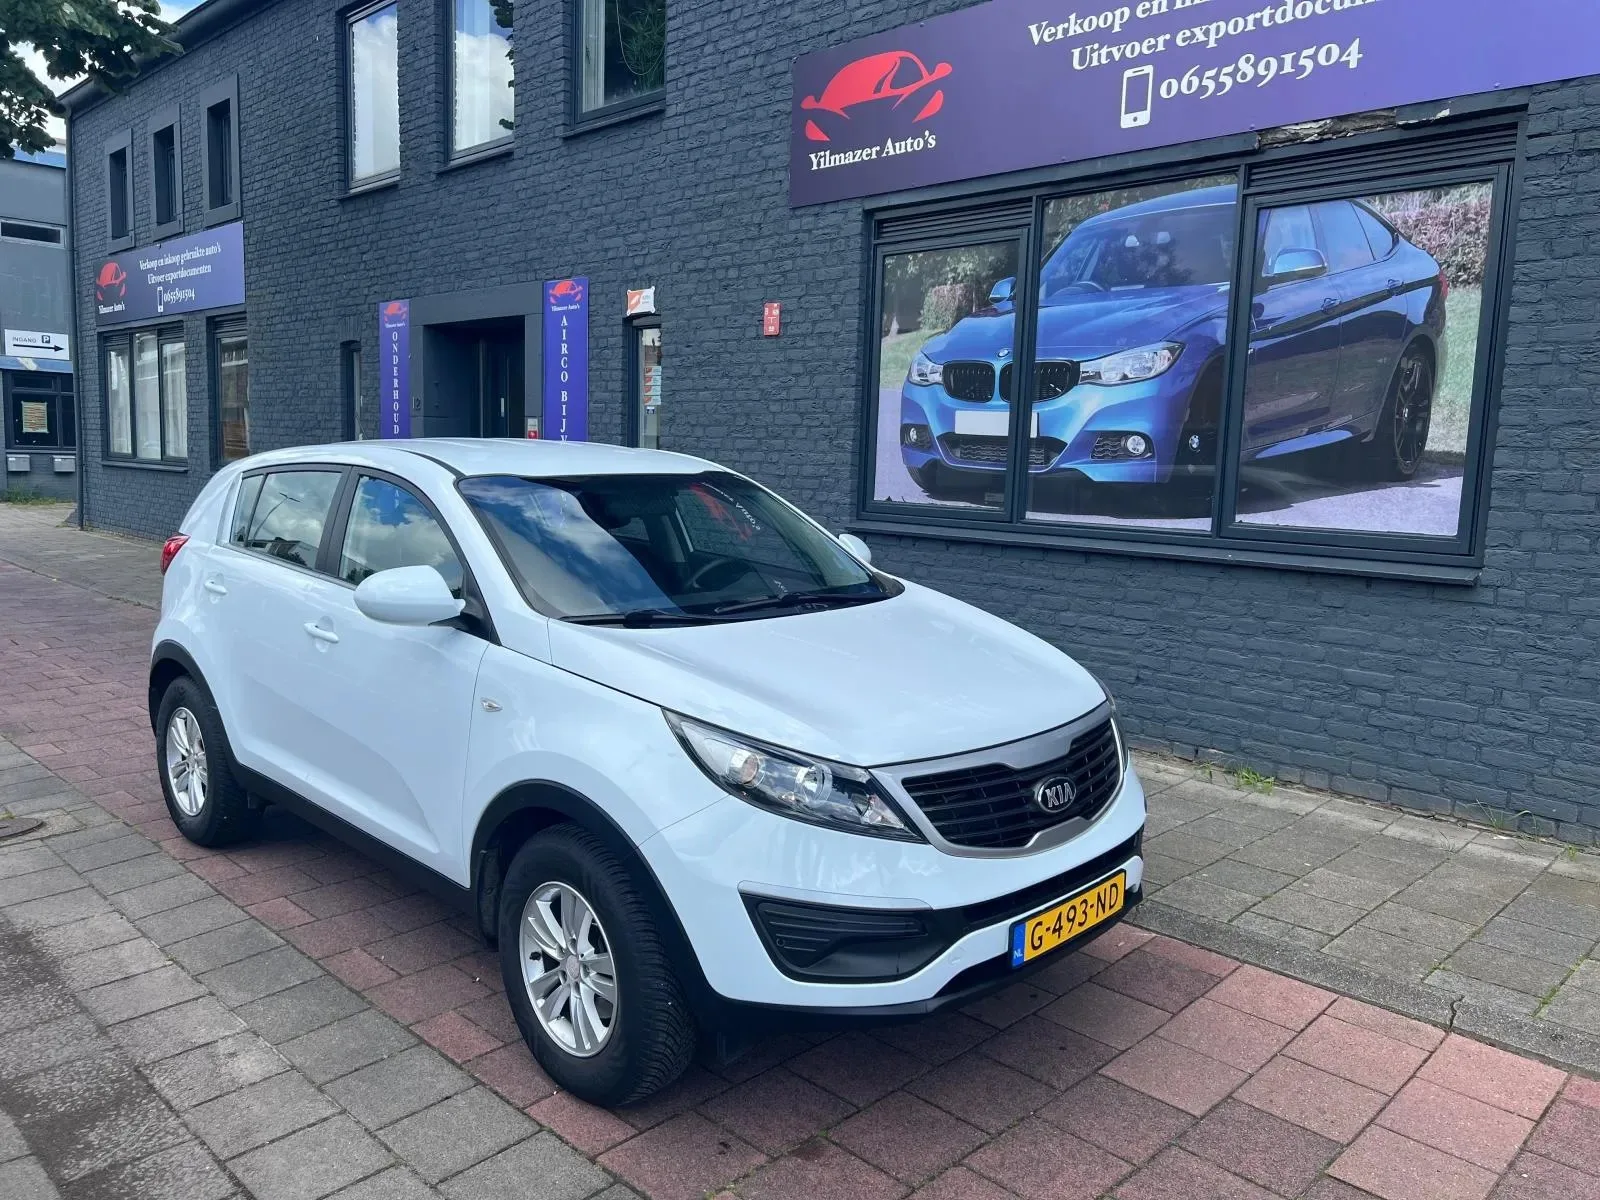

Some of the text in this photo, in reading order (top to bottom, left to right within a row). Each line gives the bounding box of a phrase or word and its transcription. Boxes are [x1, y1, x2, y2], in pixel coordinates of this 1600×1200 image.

[1027, 0, 1169, 46] Verkoop en
[1071, 0, 1380, 71] Uitvoer exportdocu
[1159, 37, 1364, 100] 0655891504
[808, 129, 937, 171] Yilmazer Auto's
[139, 259, 158, 271] Verkoop
[164, 253, 181, 266] inkoop
[180, 245, 205, 265] gebruikte
[147, 264, 212, 285] Uitvoer exportdocumenten
[163, 287, 196, 304] 0655891504
[560, 314, 569, 383] AIRCO
[392, 331, 400, 435] ONDERHOUD
[1045, 782, 1074, 808] KIA
[1030, 882, 1120, 951] G-493-ND
